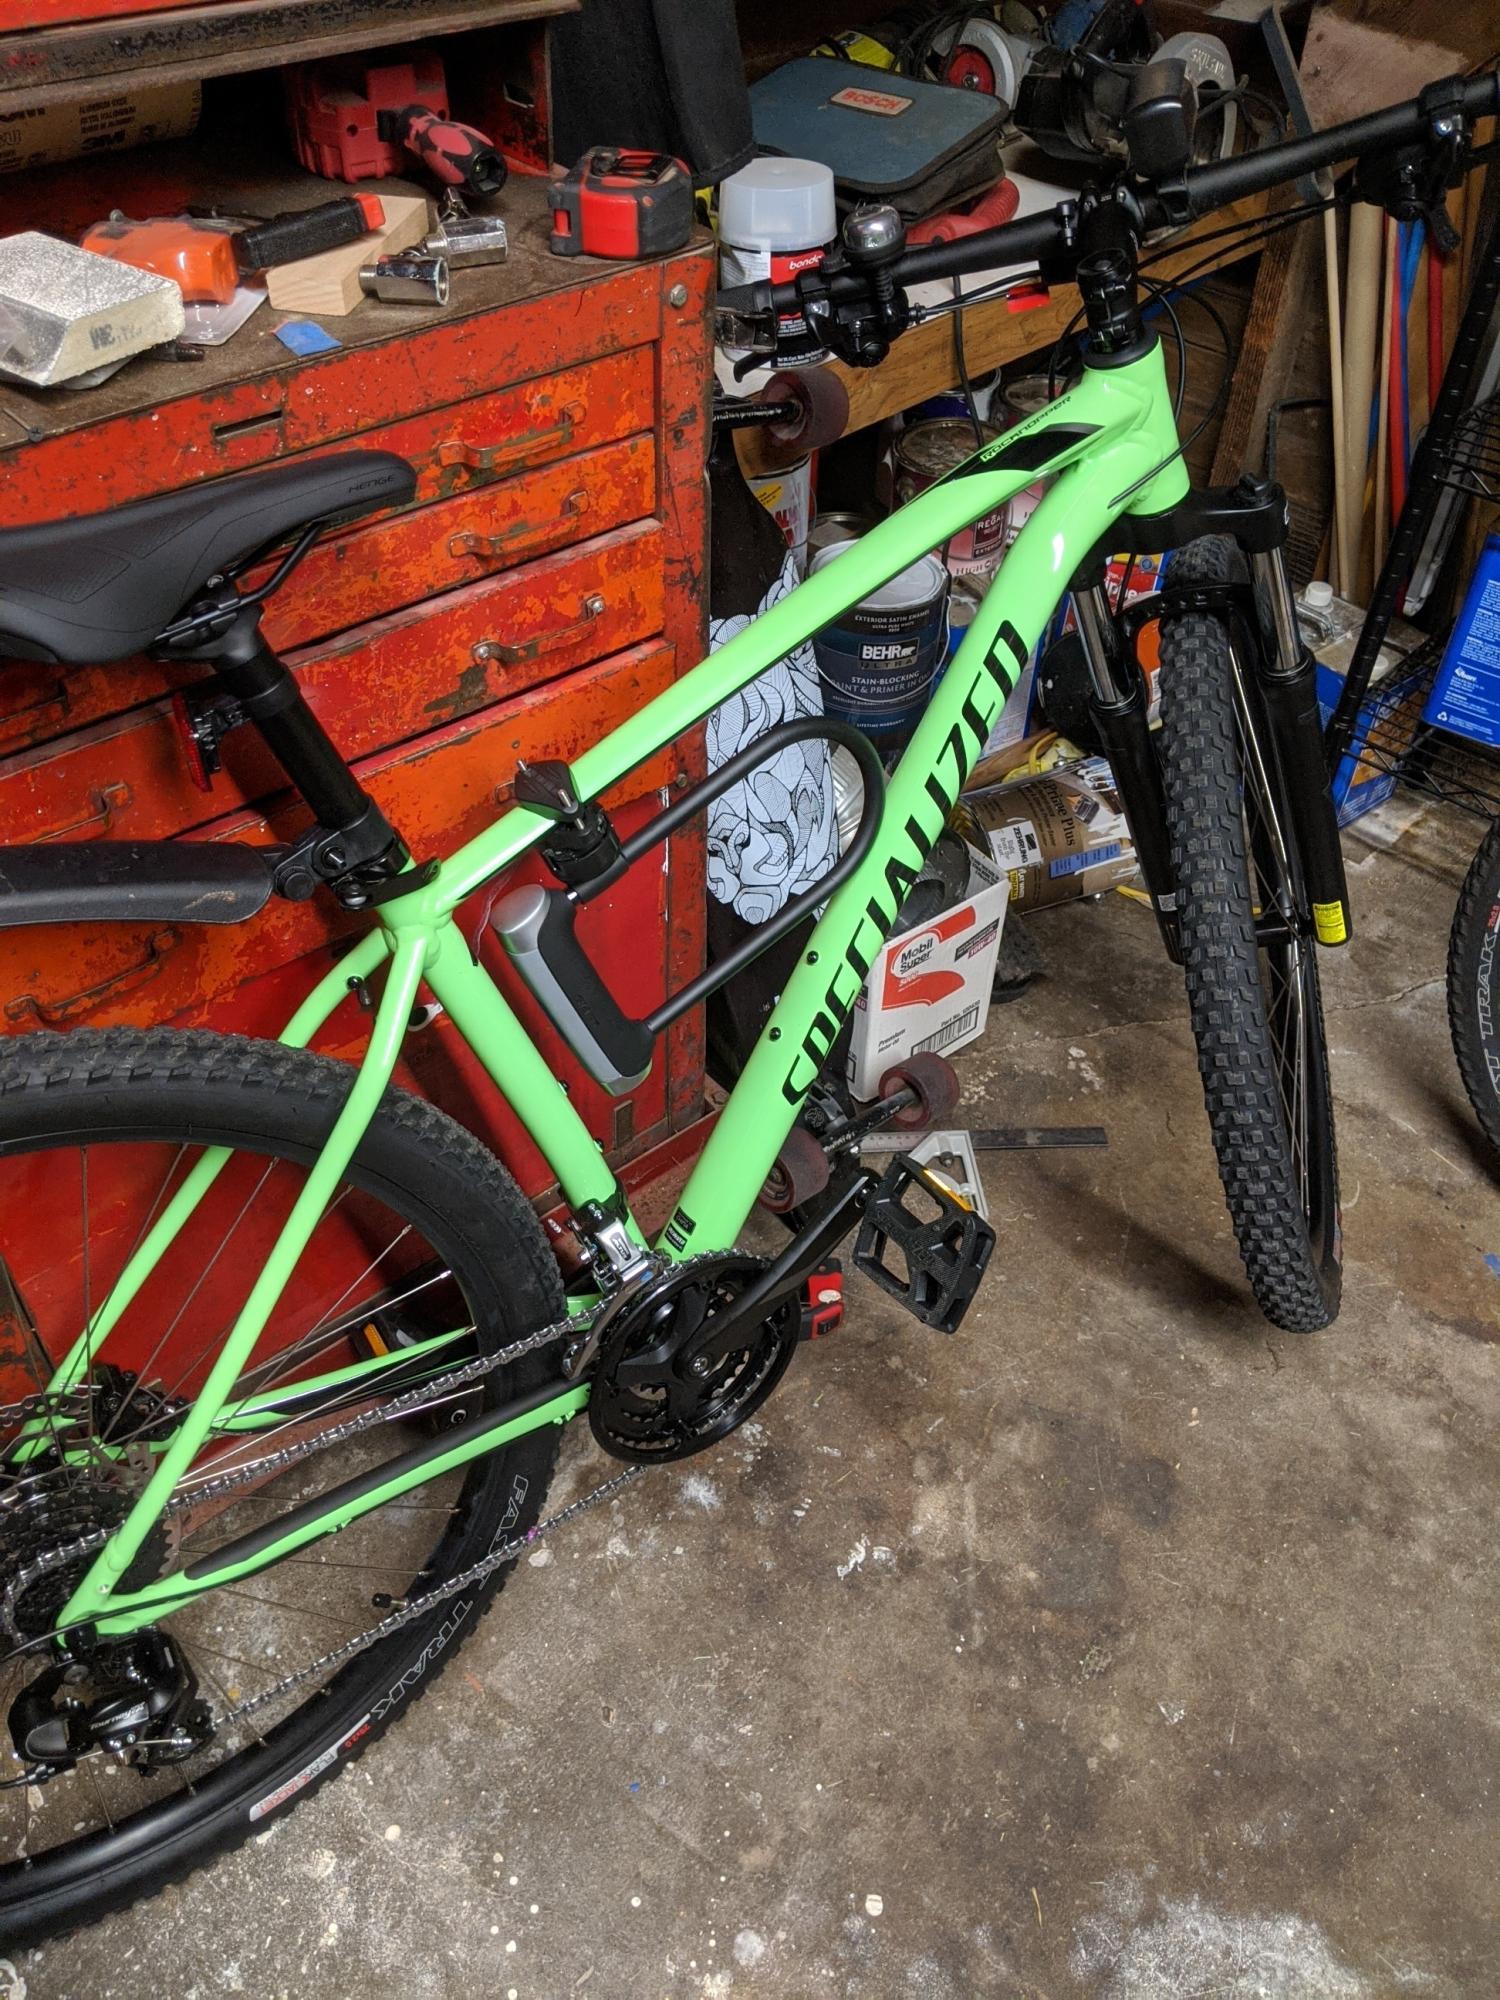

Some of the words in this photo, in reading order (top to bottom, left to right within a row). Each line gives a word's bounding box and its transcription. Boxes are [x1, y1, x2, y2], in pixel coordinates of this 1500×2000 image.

[842, 90, 905, 110] BOSCH
[854, 614, 888, 624] EXTERIOR
[862, 645, 901, 660] BEHR
[860, 659, 914, 670] ULTRA
[851, 671, 920, 686] STAIN-BLOCKING
[860, 686, 869, 695] &
[870, 684, 905, 695] PRIMER
[1060, 816, 1076, 847] Plus
[1012, 826, 1029, 864] ZEHRUNG
[900, 937, 934, 963] Mobil
[899, 950, 933, 975] Super
[1476, 933, 1498, 1041] TRAK
[878, 1028, 906, 1047] Premium
[370, 1600, 474, 1721] TRAK
